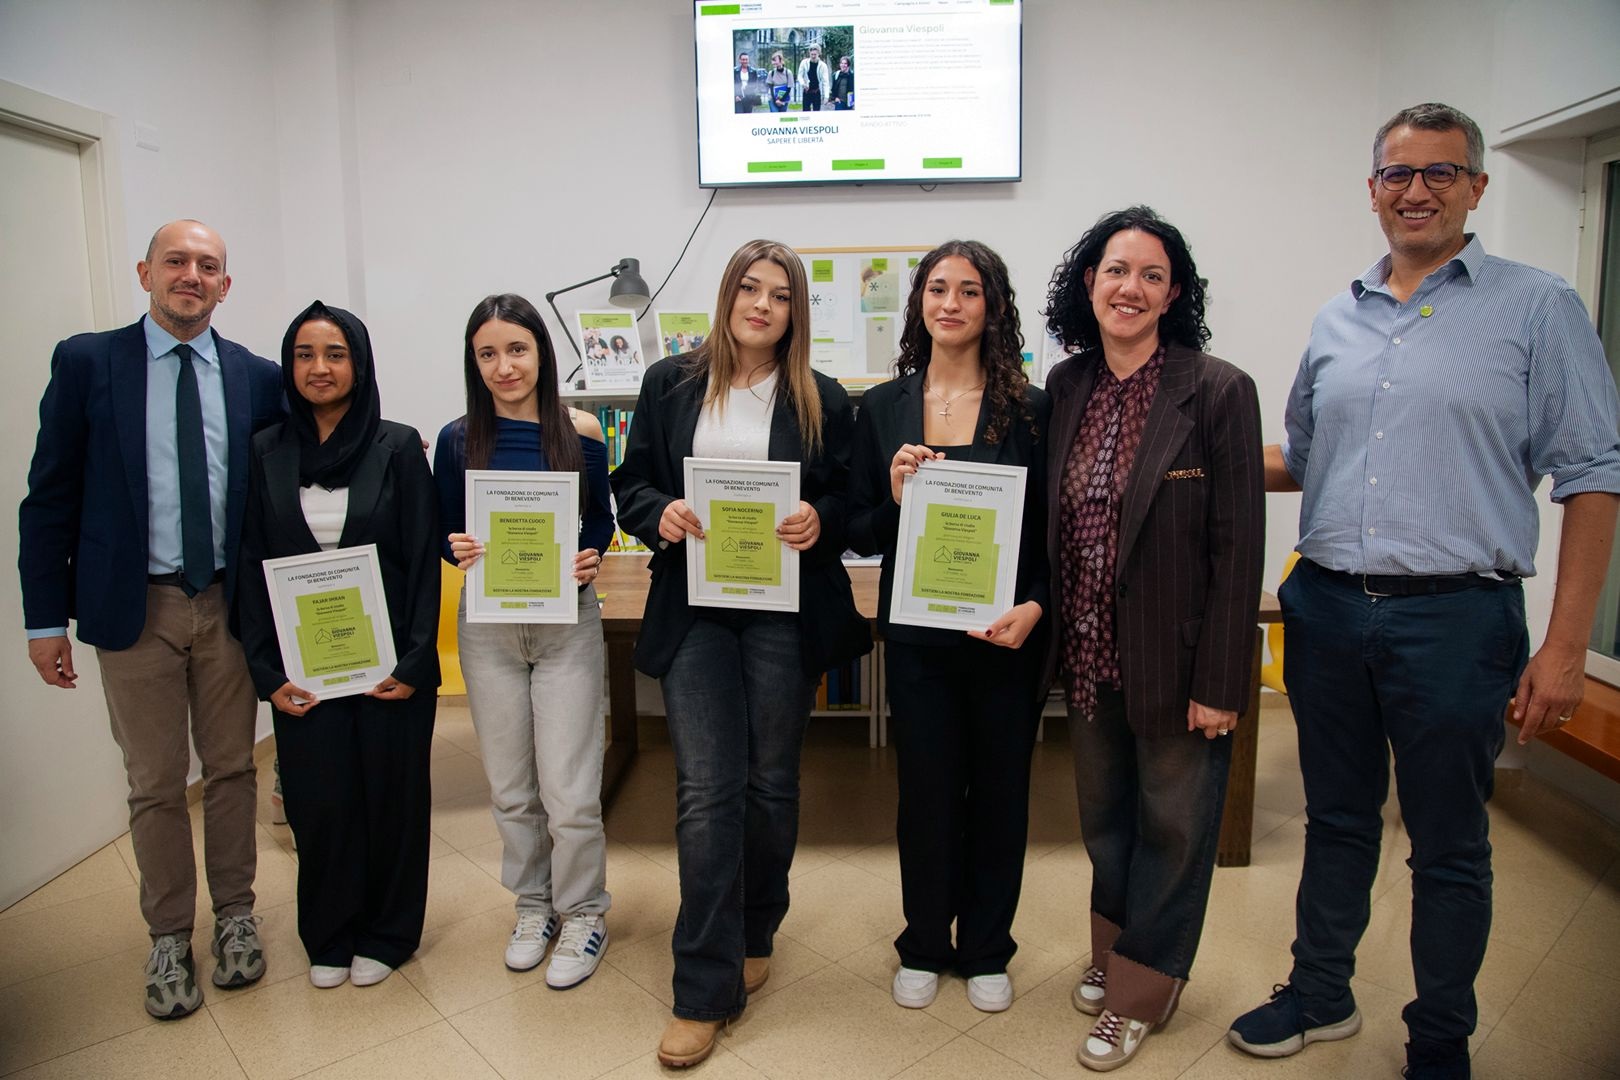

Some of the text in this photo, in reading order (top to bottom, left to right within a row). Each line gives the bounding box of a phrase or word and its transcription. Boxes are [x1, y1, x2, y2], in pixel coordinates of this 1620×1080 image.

[859, 24, 944, 36] Giovanna Viespoli
[751, 125, 839, 136] GIOVANNA VIESPOLI
[933, 480, 968, 489] FONDAZIONE
[974, 483, 1003, 492] COMUNITÀ
[951, 488, 983, 497] BENEVENTO
[953, 550, 980, 558] GIOVANNA
[294, 571, 327, 581] FONDAZIONE
[333, 566, 360, 575] COMUNITÀ
[313, 574, 343, 584] BENEVENTO
